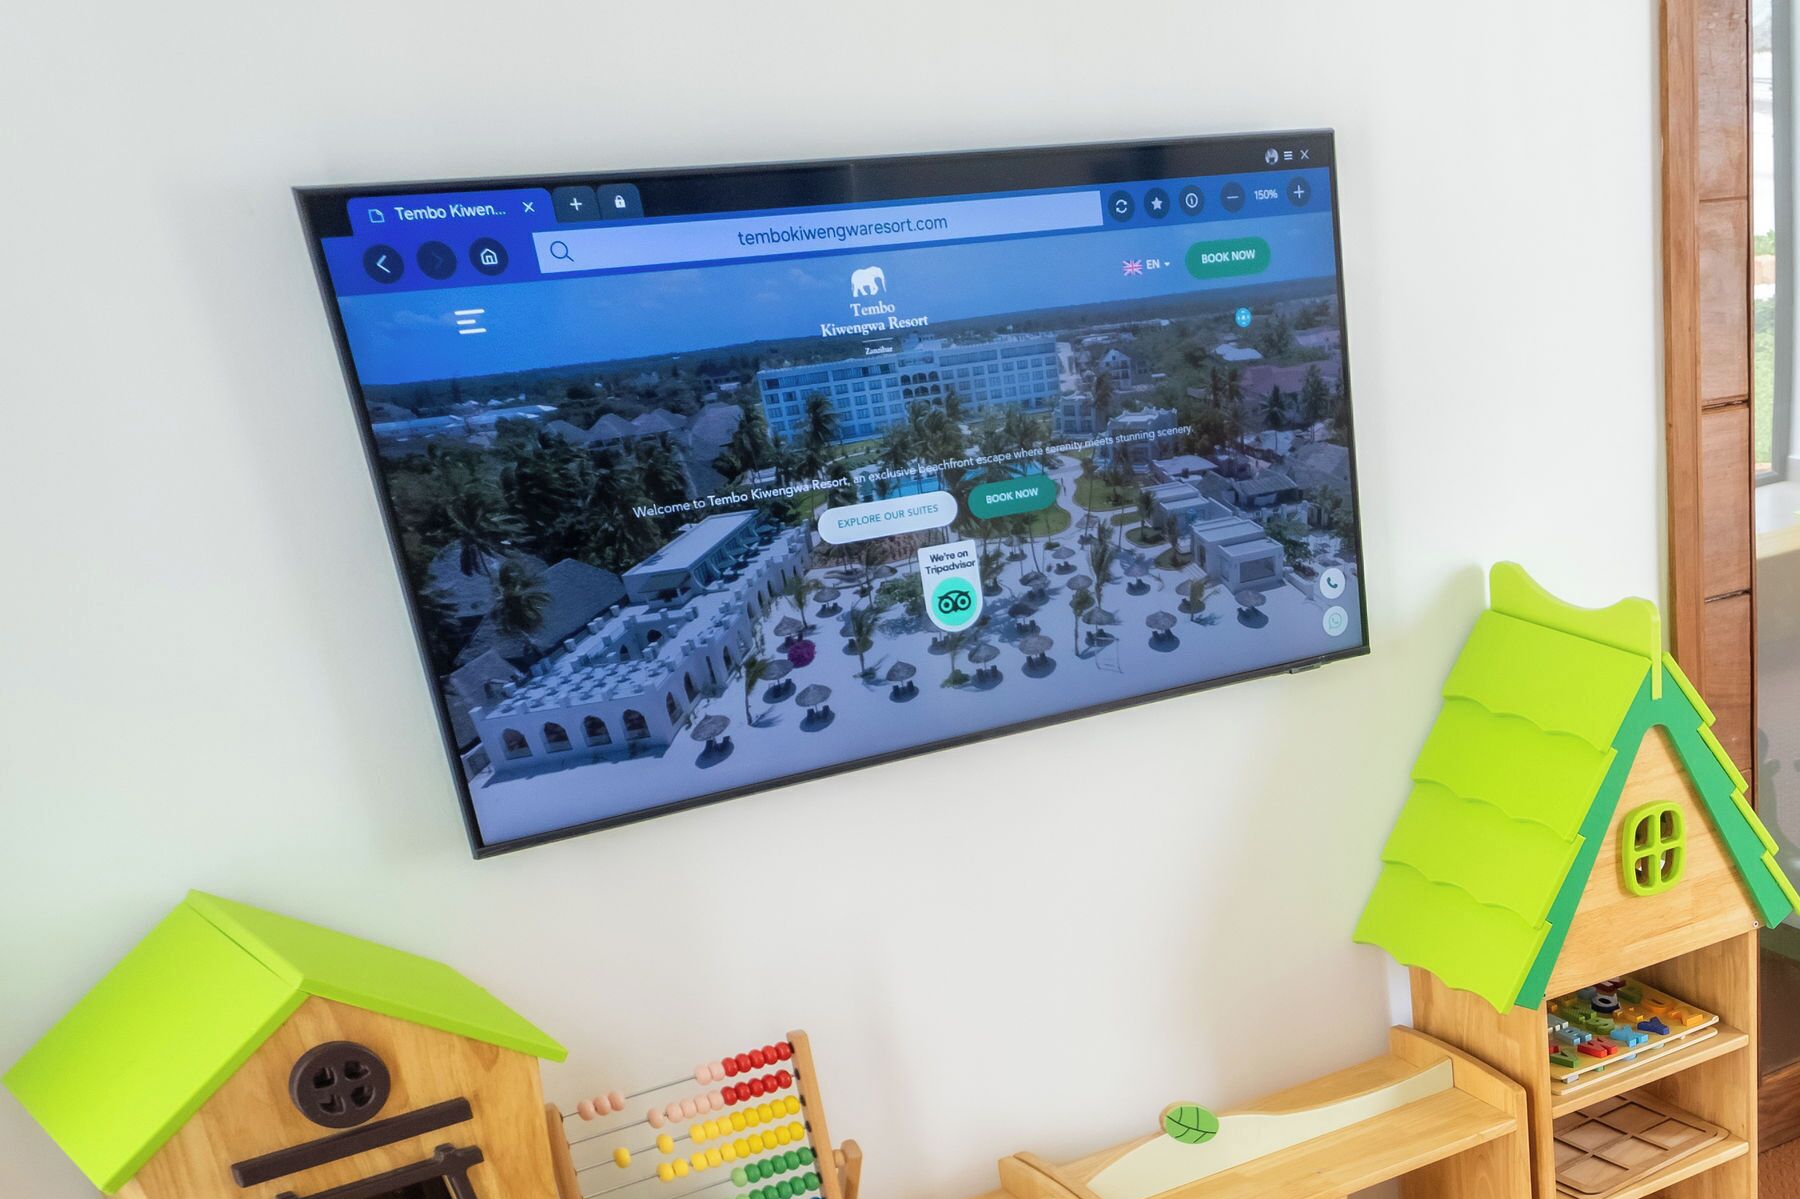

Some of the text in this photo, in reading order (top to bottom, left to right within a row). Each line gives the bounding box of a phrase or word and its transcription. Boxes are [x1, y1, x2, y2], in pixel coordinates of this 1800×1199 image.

[1254, 189, 1278, 200] 150%
[394, 206, 447, 220] Tembo
[738, 217, 948, 246] tembokiwengwaresort.com
[1146, 259, 1160, 270] EN
[1201, 249, 1255, 264] BOOK NOW
[850, 300, 895, 317] Tembo
[820, 316, 928, 338] Kiwengwa Resort
[632, 425, 1195, 518] Welcome to Tembo Kiwengwa Resort, an exclusive beachfront escape where serenity meets stunning scenery.
[985, 487, 1039, 504] BOOK NOW
[837, 504, 939, 528] EXPLORE OUR SUITES
[929, 550, 969, 563] We're on
[925, 559, 976, 575] Tripadvisor
